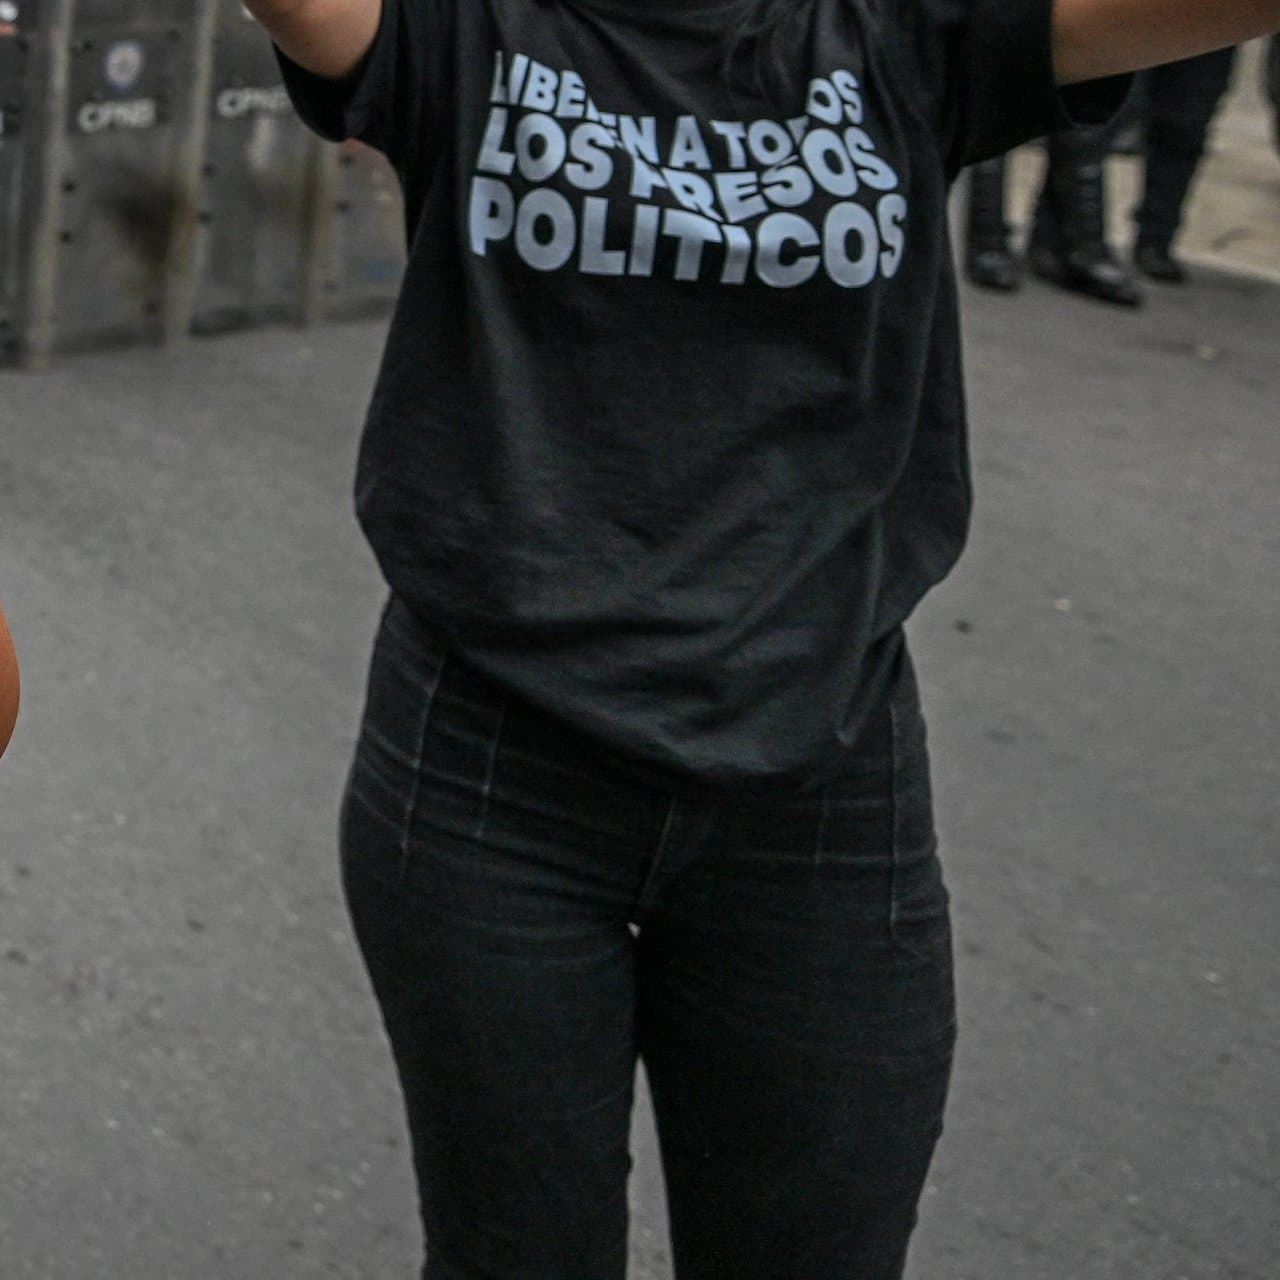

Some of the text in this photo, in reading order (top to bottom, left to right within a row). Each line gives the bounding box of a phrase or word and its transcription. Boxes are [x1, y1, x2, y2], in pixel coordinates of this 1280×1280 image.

[477, 106, 614, 190] LOS
[669, 115, 713, 171] A
[468, 176, 908, 288] POLITICOS
